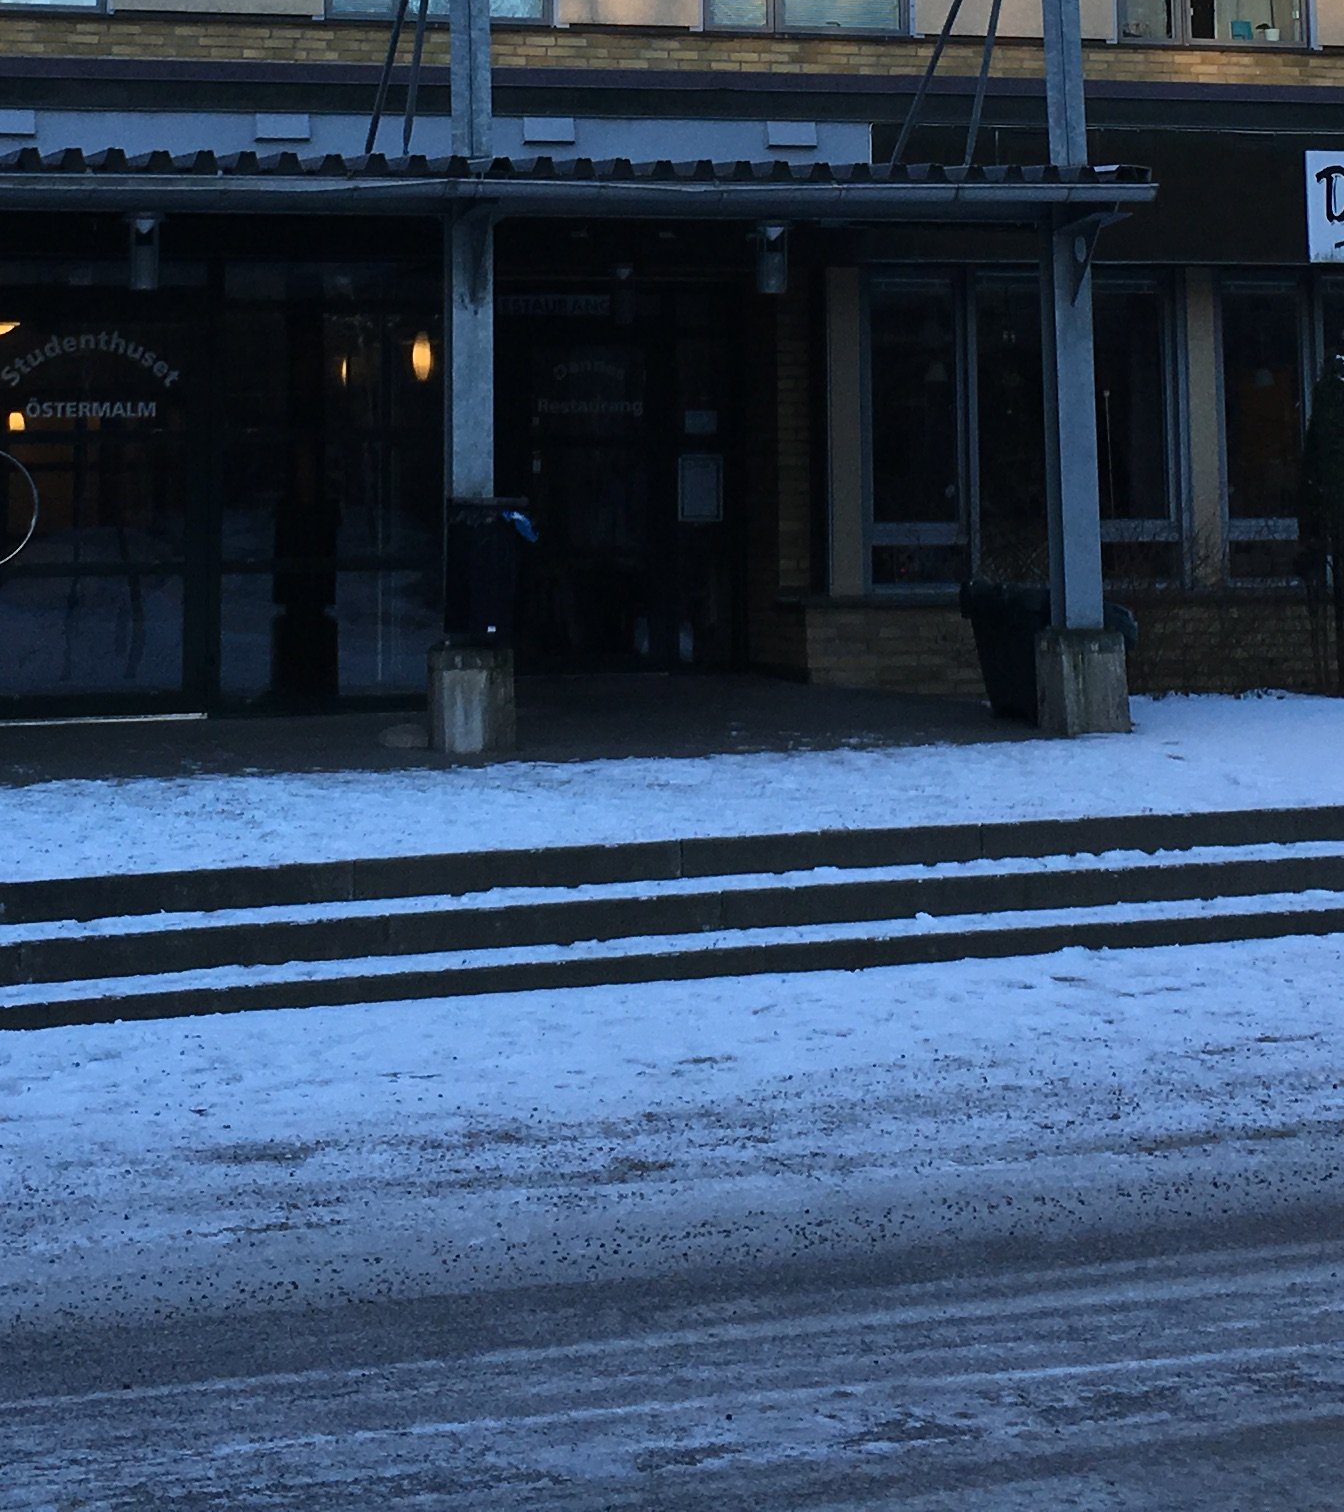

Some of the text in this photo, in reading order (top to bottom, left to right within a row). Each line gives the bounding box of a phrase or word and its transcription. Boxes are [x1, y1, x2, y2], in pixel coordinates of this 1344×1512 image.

[0, 330, 180, 388] Studenthuset
[26, 397, 157, 419] ÖSTERMALM
[537, 398, 644, 417] Restaurang
